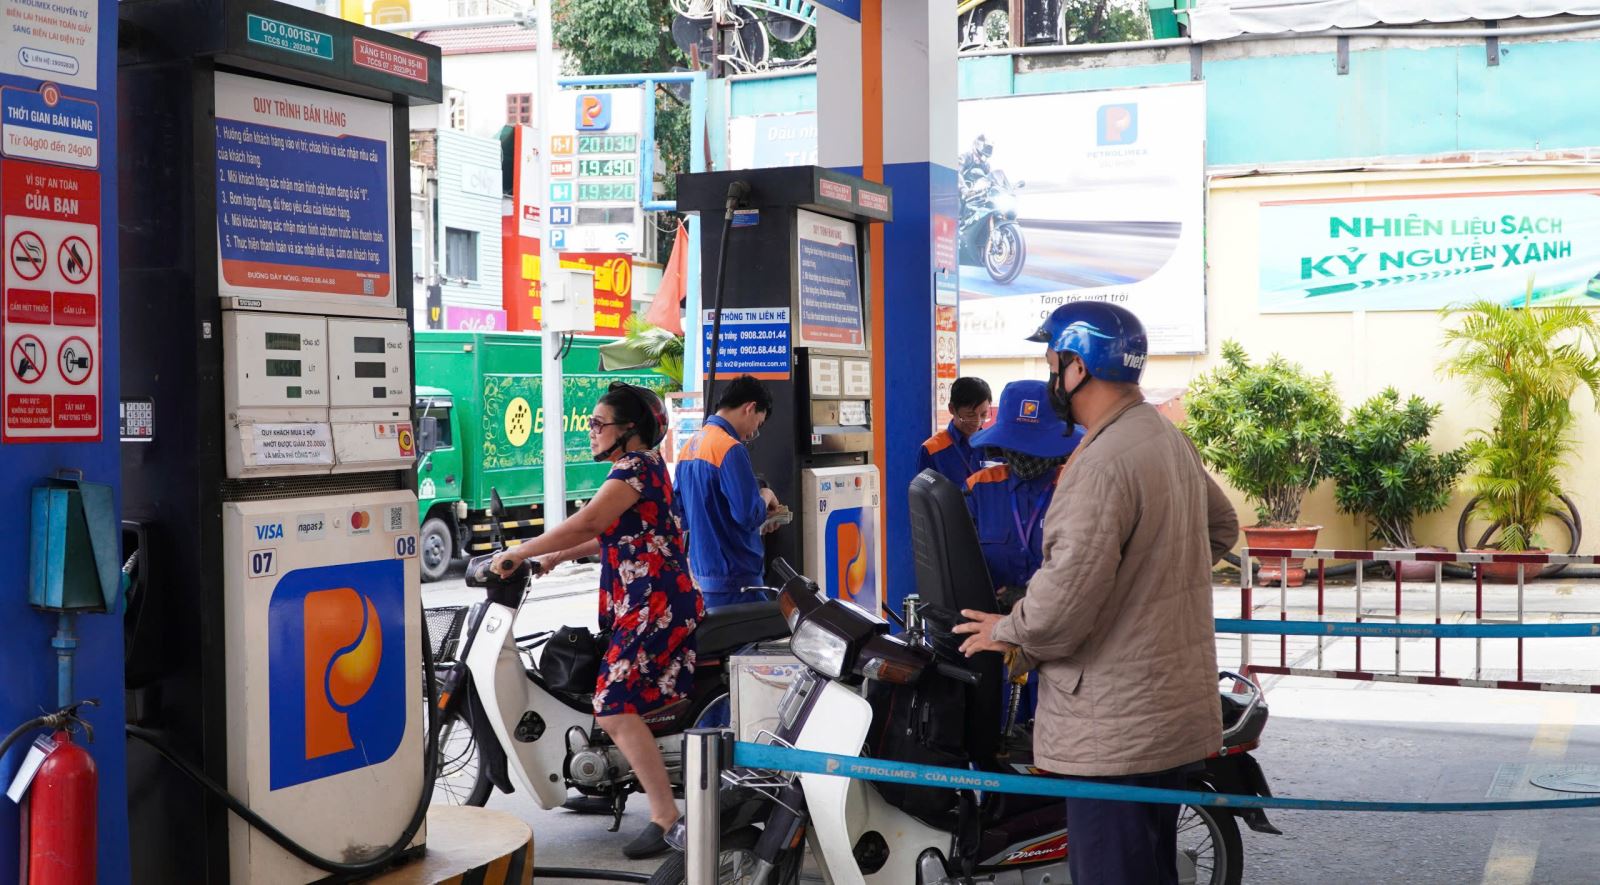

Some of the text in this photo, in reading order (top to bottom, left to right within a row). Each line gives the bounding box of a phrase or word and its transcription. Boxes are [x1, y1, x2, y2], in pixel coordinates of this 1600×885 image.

[35, 14, 57, 25] THANH
[261, 20, 277, 34] DO
[13, 25, 31, 35] SANG
[49, 32, 59, 40] LAI
[264, 35, 281, 45] TCCS
[360, 44, 379, 58] XĂNG
[380, 50, 392, 61] E10
[393, 53, 407, 65] RON
[367, 57, 382, 67] TCCS
[8, 106, 93, 131] THỜI GIAN BÁN HÀNG
[253, 97, 346, 127] QUY TRÌNH BÁN HÀNG
[9, 133, 92, 157] Từ 04g00 đến 24g00
[223, 126, 242, 144] Hướng
[254, 131, 270, 146] khách
[271, 134, 284, 151] hàng
[285, 136, 294, 149] vào
[309, 140, 321, 154] chào
[330, 143, 336, 155] và
[337, 145, 346, 158] xác
[347, 147, 358, 161] nhận
[360, 149, 368, 161] nhu
[369, 149, 378, 162] cầu
[229, 148, 245, 162] khách
[580, 160, 634, 176] 19.490
[35, 177, 45, 189] SỰ
[48, 179, 58, 189] AN
[60, 180, 78, 191] TOÀN
[239, 171, 255, 185] khách
[256, 173, 269, 190] hàng
[270, 176, 279, 189] xác
[280, 178, 293, 193] nhận
[337, 186, 349, 201] đang
[26, 189, 78, 217] CỦA BẠN
[230, 192, 242, 205] Bơm
[243, 194, 256, 210] hàng
[281, 198, 292, 211] theo
[293, 200, 302, 215] yêu
[303, 200, 312, 213] cầu
[322, 204, 337, 217] khách
[242, 215, 258, 228] khách
[259, 217, 272, 233] hàng
[1329, 214, 1562, 240] NHIÊN LIỆU SẠCH
[260, 238, 275, 251] thanh
[353, 248, 367, 260] khách
[1301, 240, 1571, 279] KỶ NGUYÊN XANH
[759, 311, 774, 320] LIÊN
[777, 311, 786, 322] HỆ
[740, 331, 786, 340] 0908.20.01.44
[821, 482, 832, 491] VISA
[820, 500, 827, 512] 09
[255, 524, 284, 539] VISA
[298, 522, 318, 532] napas
[397, 536, 416, 556] 08
[252, 552, 273, 574] 07
[851, 765, 999, 787] PETROLIMEX CỬA HÀNG 06
[1006, 849, 1055, 861] Dream
